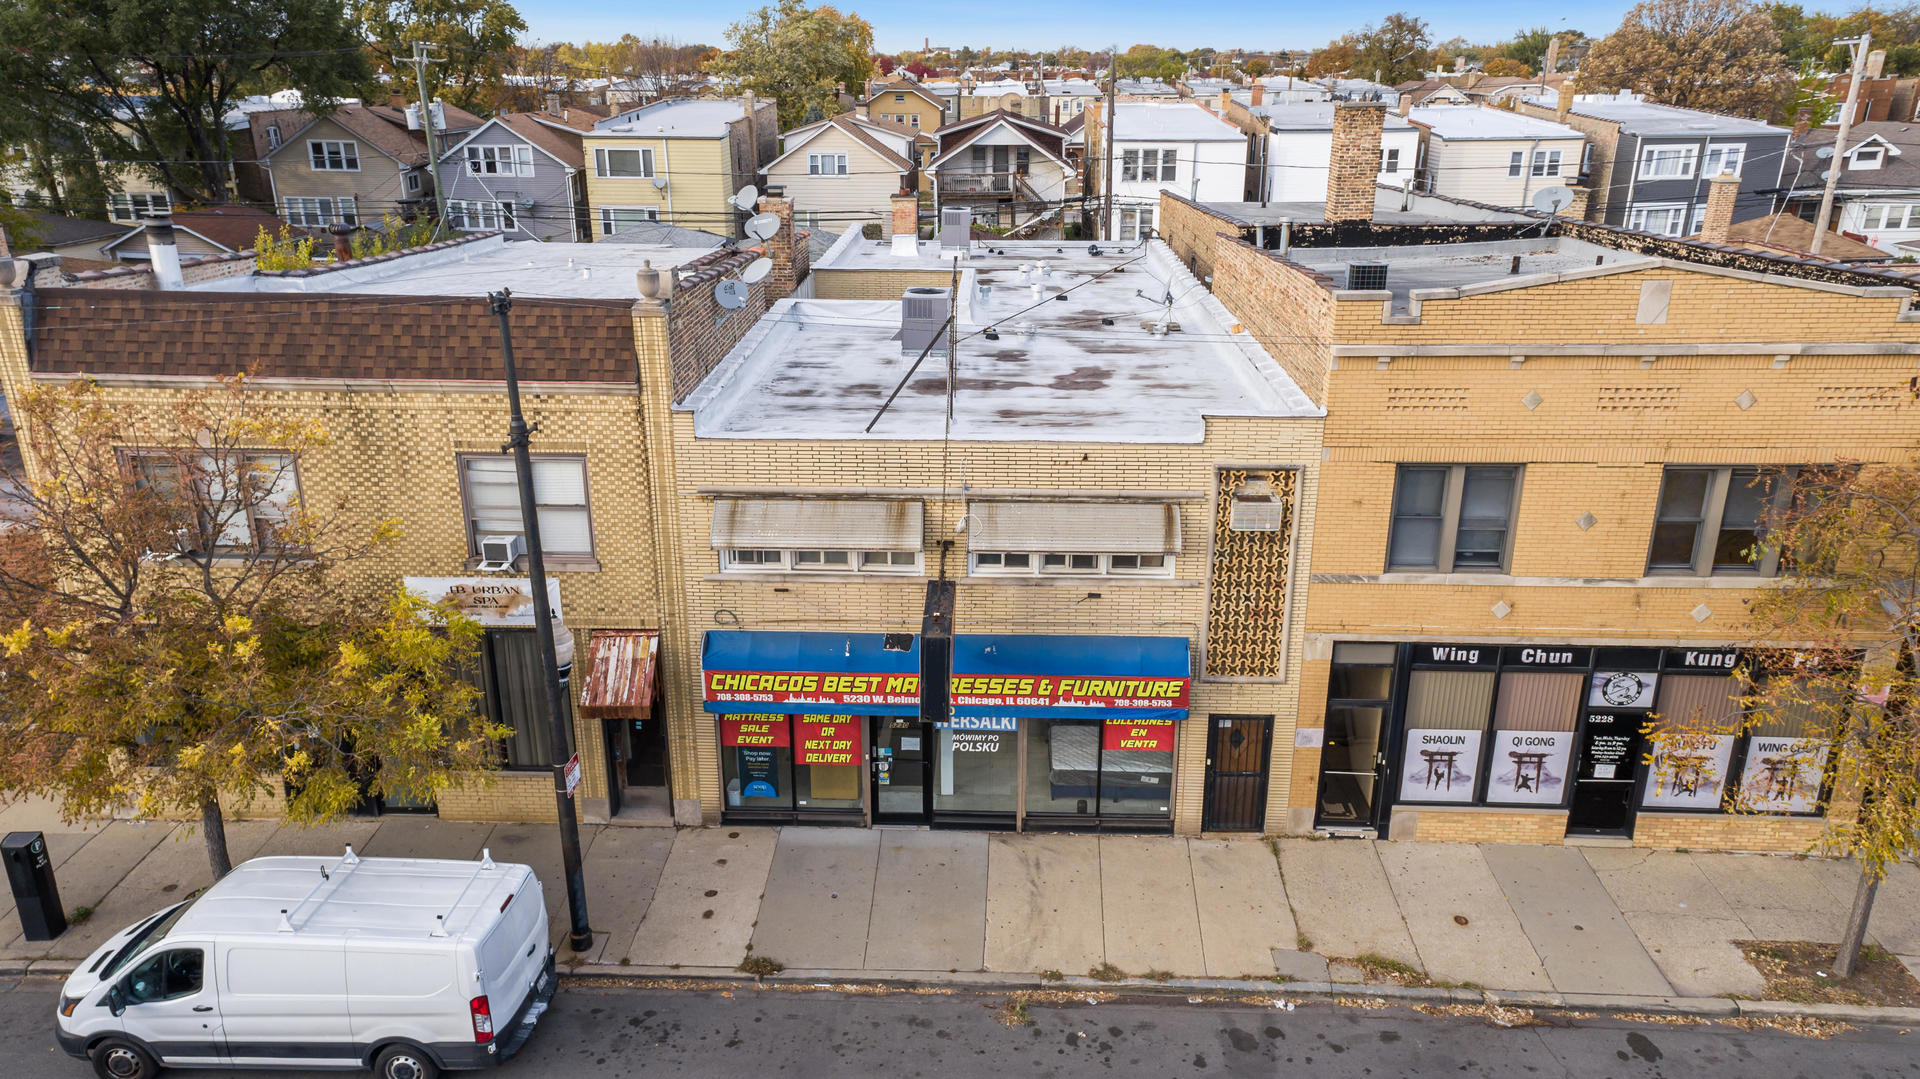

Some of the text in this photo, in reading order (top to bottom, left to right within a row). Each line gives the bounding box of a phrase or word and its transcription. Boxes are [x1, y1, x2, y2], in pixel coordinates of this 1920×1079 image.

[472, 586, 520, 594] URBAN
[473, 597, 499, 605] SPA
[1432, 647, 1479, 664] Wing
[1521, 648, 1573, 664] Chun
[1684, 651, 1737, 668] Kung
[711, 674, 1184, 698] CHICAGOS BEST MARESSES & FURNITURE
[716, 693, 774, 702] 708-308-5753
[843, 695, 870, 703] 5230
[872, 695, 886, 703] W.
[887, 695, 921, 704] Belmo
[957, 696, 1004, 705] Chicago,
[1005, 697, 1015, 705] IL
[1017, 697, 1050, 705] 60641
[1114, 699, 1173, 707] 708-308-5753
[724, 713, 785, 722] MATTRESS
[802, 714, 853, 724] SAME DAY
[1589, 715, 1614, 723] 5228
[739, 724, 770, 733] SALE
[821, 727, 835, 737] OR
[1130, 728, 1148, 737] EN
[736, 735, 774, 744] EVENT
[952, 733, 999, 742] MÓWIMY PO
[1422, 735, 1466, 745] SHAOLIN
[1512, 736, 1555, 747] QI GONG
[804, 740, 853, 750] NEXT DAY
[952, 742, 999, 752] POLSKU
[1120, 740, 1158, 748] VENTA
[1758, 743, 1788, 753] WING
[805, 753, 852, 763] DELIVERY
